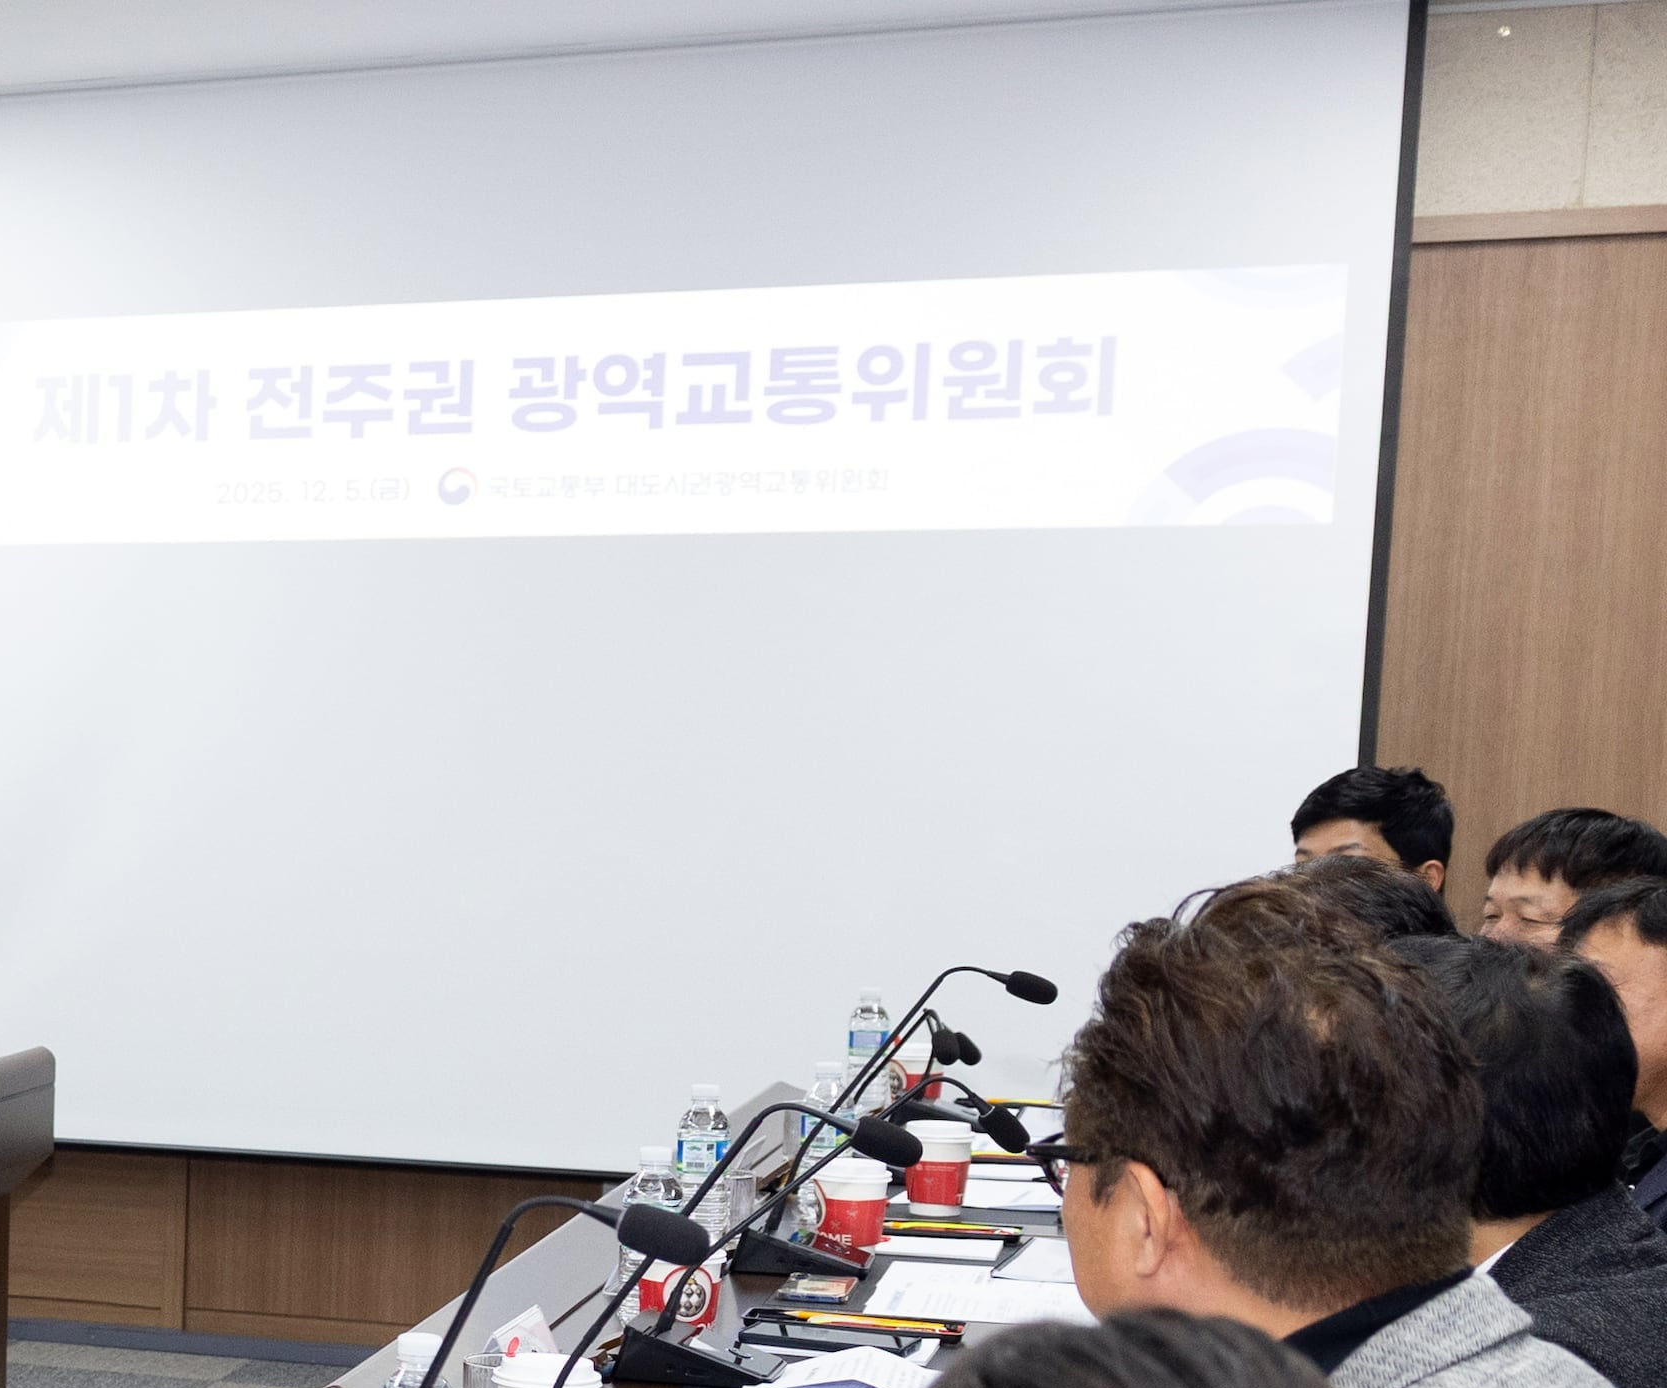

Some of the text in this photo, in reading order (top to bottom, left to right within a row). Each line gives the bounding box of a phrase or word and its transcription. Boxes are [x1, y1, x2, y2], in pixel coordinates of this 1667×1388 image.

[33, 335, 1117, 444] 제1차 전주권 광역교통위원회
[487, 474, 607, 500] 국토교통부
